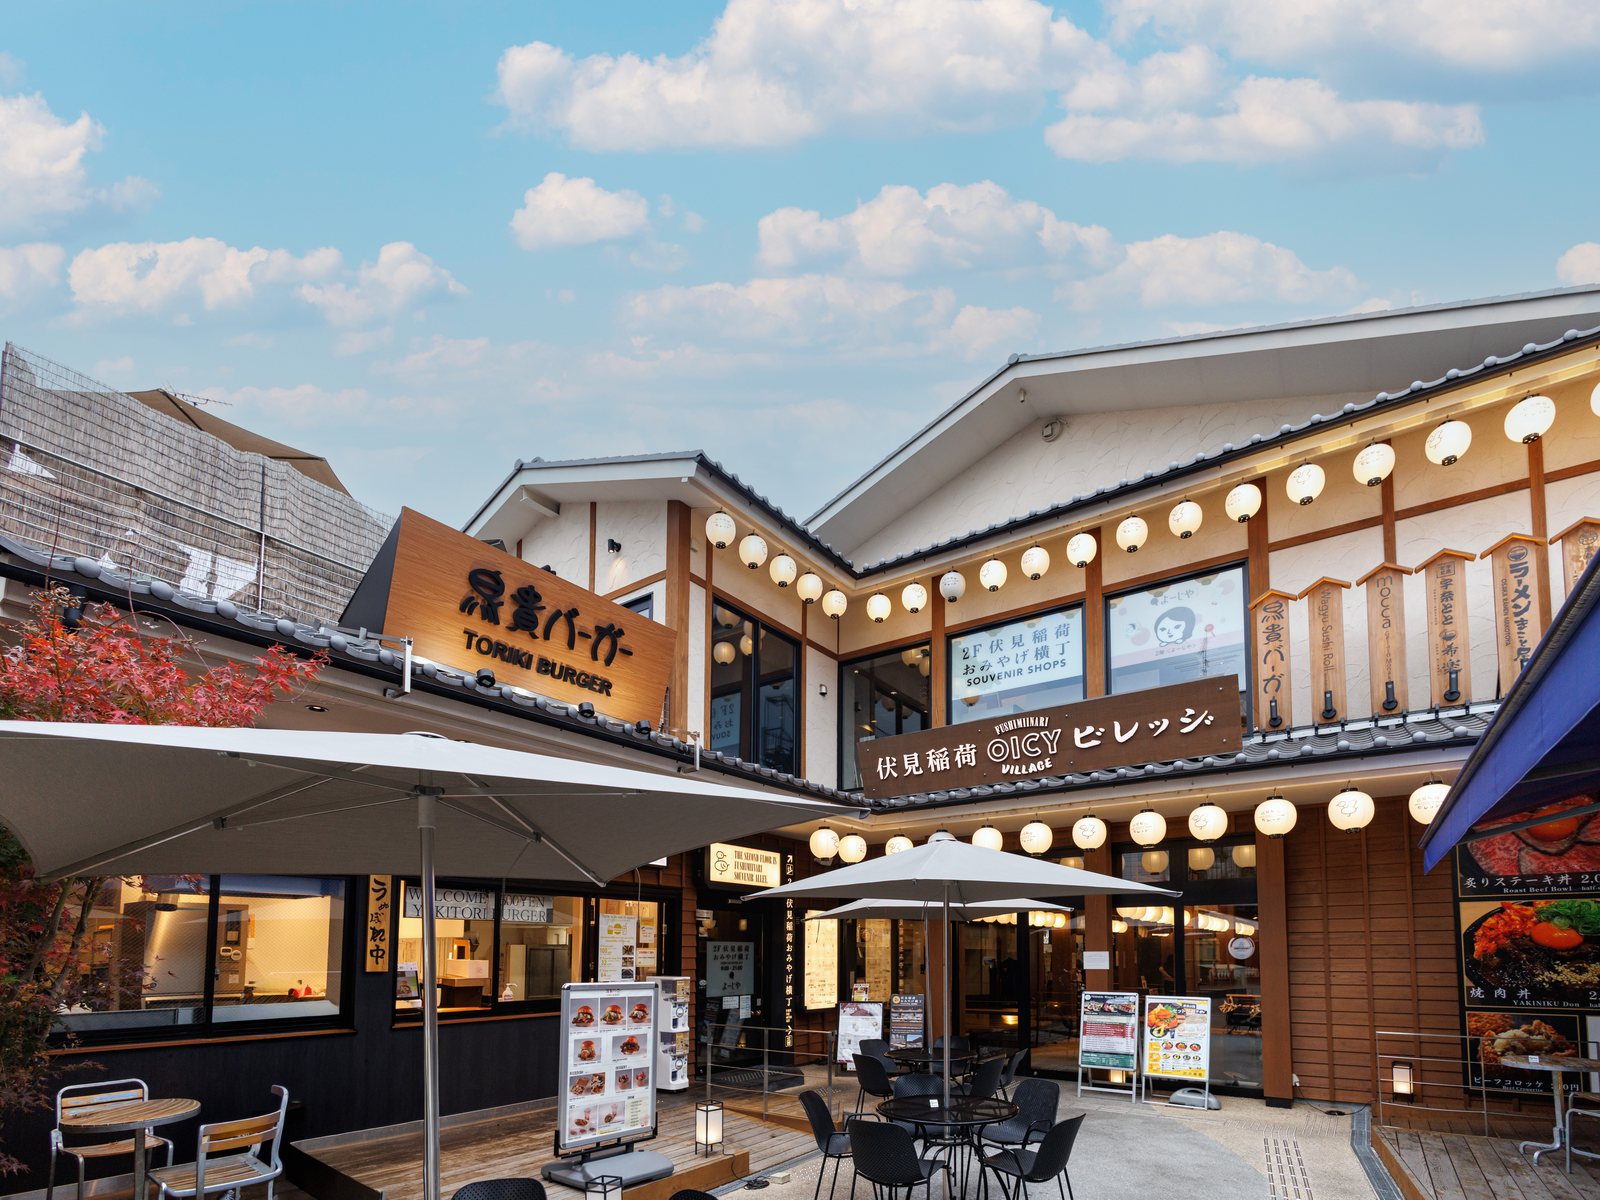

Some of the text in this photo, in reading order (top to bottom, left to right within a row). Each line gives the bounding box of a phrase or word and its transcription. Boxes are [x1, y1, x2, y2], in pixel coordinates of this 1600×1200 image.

[1318, 588, 1332, 621] Wagyu
[962, 623, 1071, 660] 2F 伏見稲荷
[1322, 625, 1333, 652] Sushi
[463, 628, 613, 697] TORIKI BURGER
[962, 641, 1071, 676] おみやげ横丁
[1323, 653, 1335, 672] Roll
[966, 658, 1067, 687] SOUVENIR SHOPS
[994, 716, 1049, 736] FUSHIMIINARI
[876, 708, 1215, 780] 伏見稲荷 OICY ビレッジ
[1001, 758, 1053, 775] VILLAGE
[744, 852, 759, 862] SECOND
[760, 854, 772, 864] FLOOR
[734, 872, 754, 882] SOUVENIR
[1464, 874, 1572, 889] 炙りステーキ丼
[408, 887, 487, 904] WLCOME
[413, 904, 487, 920] YKITORI
